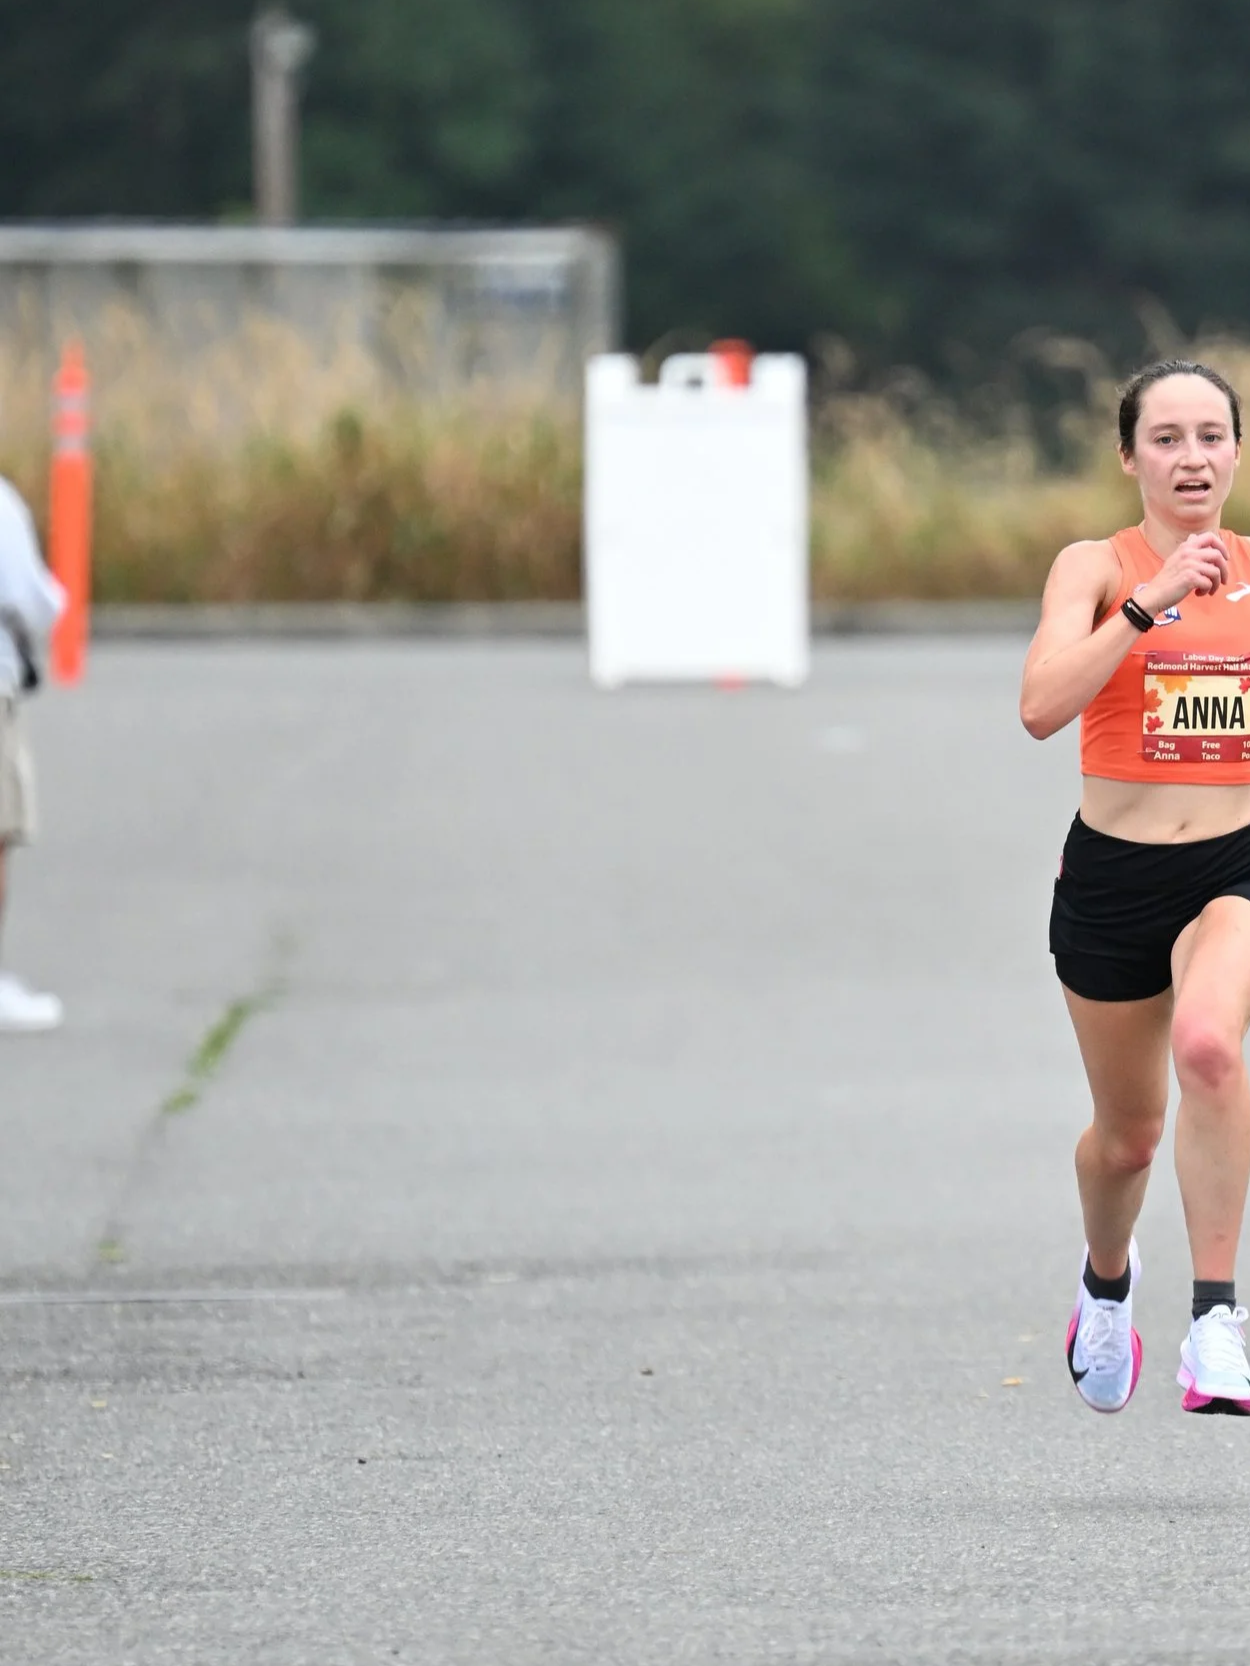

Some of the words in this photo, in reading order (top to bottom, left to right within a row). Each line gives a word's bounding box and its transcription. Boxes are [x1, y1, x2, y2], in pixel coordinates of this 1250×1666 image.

[1182, 653, 1207, 661] Labor
[1208, 654, 1225, 663] Day
[1147, 662, 1189, 671] Redmond
[1189, 662, 1222, 671] Harvest
[1222, 662, 1240, 671] Half
[1172, 696, 1246, 730] ANNA
[1158, 740, 1176, 751] Bag
[1201, 740, 1221, 749] Free
[1153, 751, 1180, 761] Anna
[1201, 752, 1221, 761] Taco
